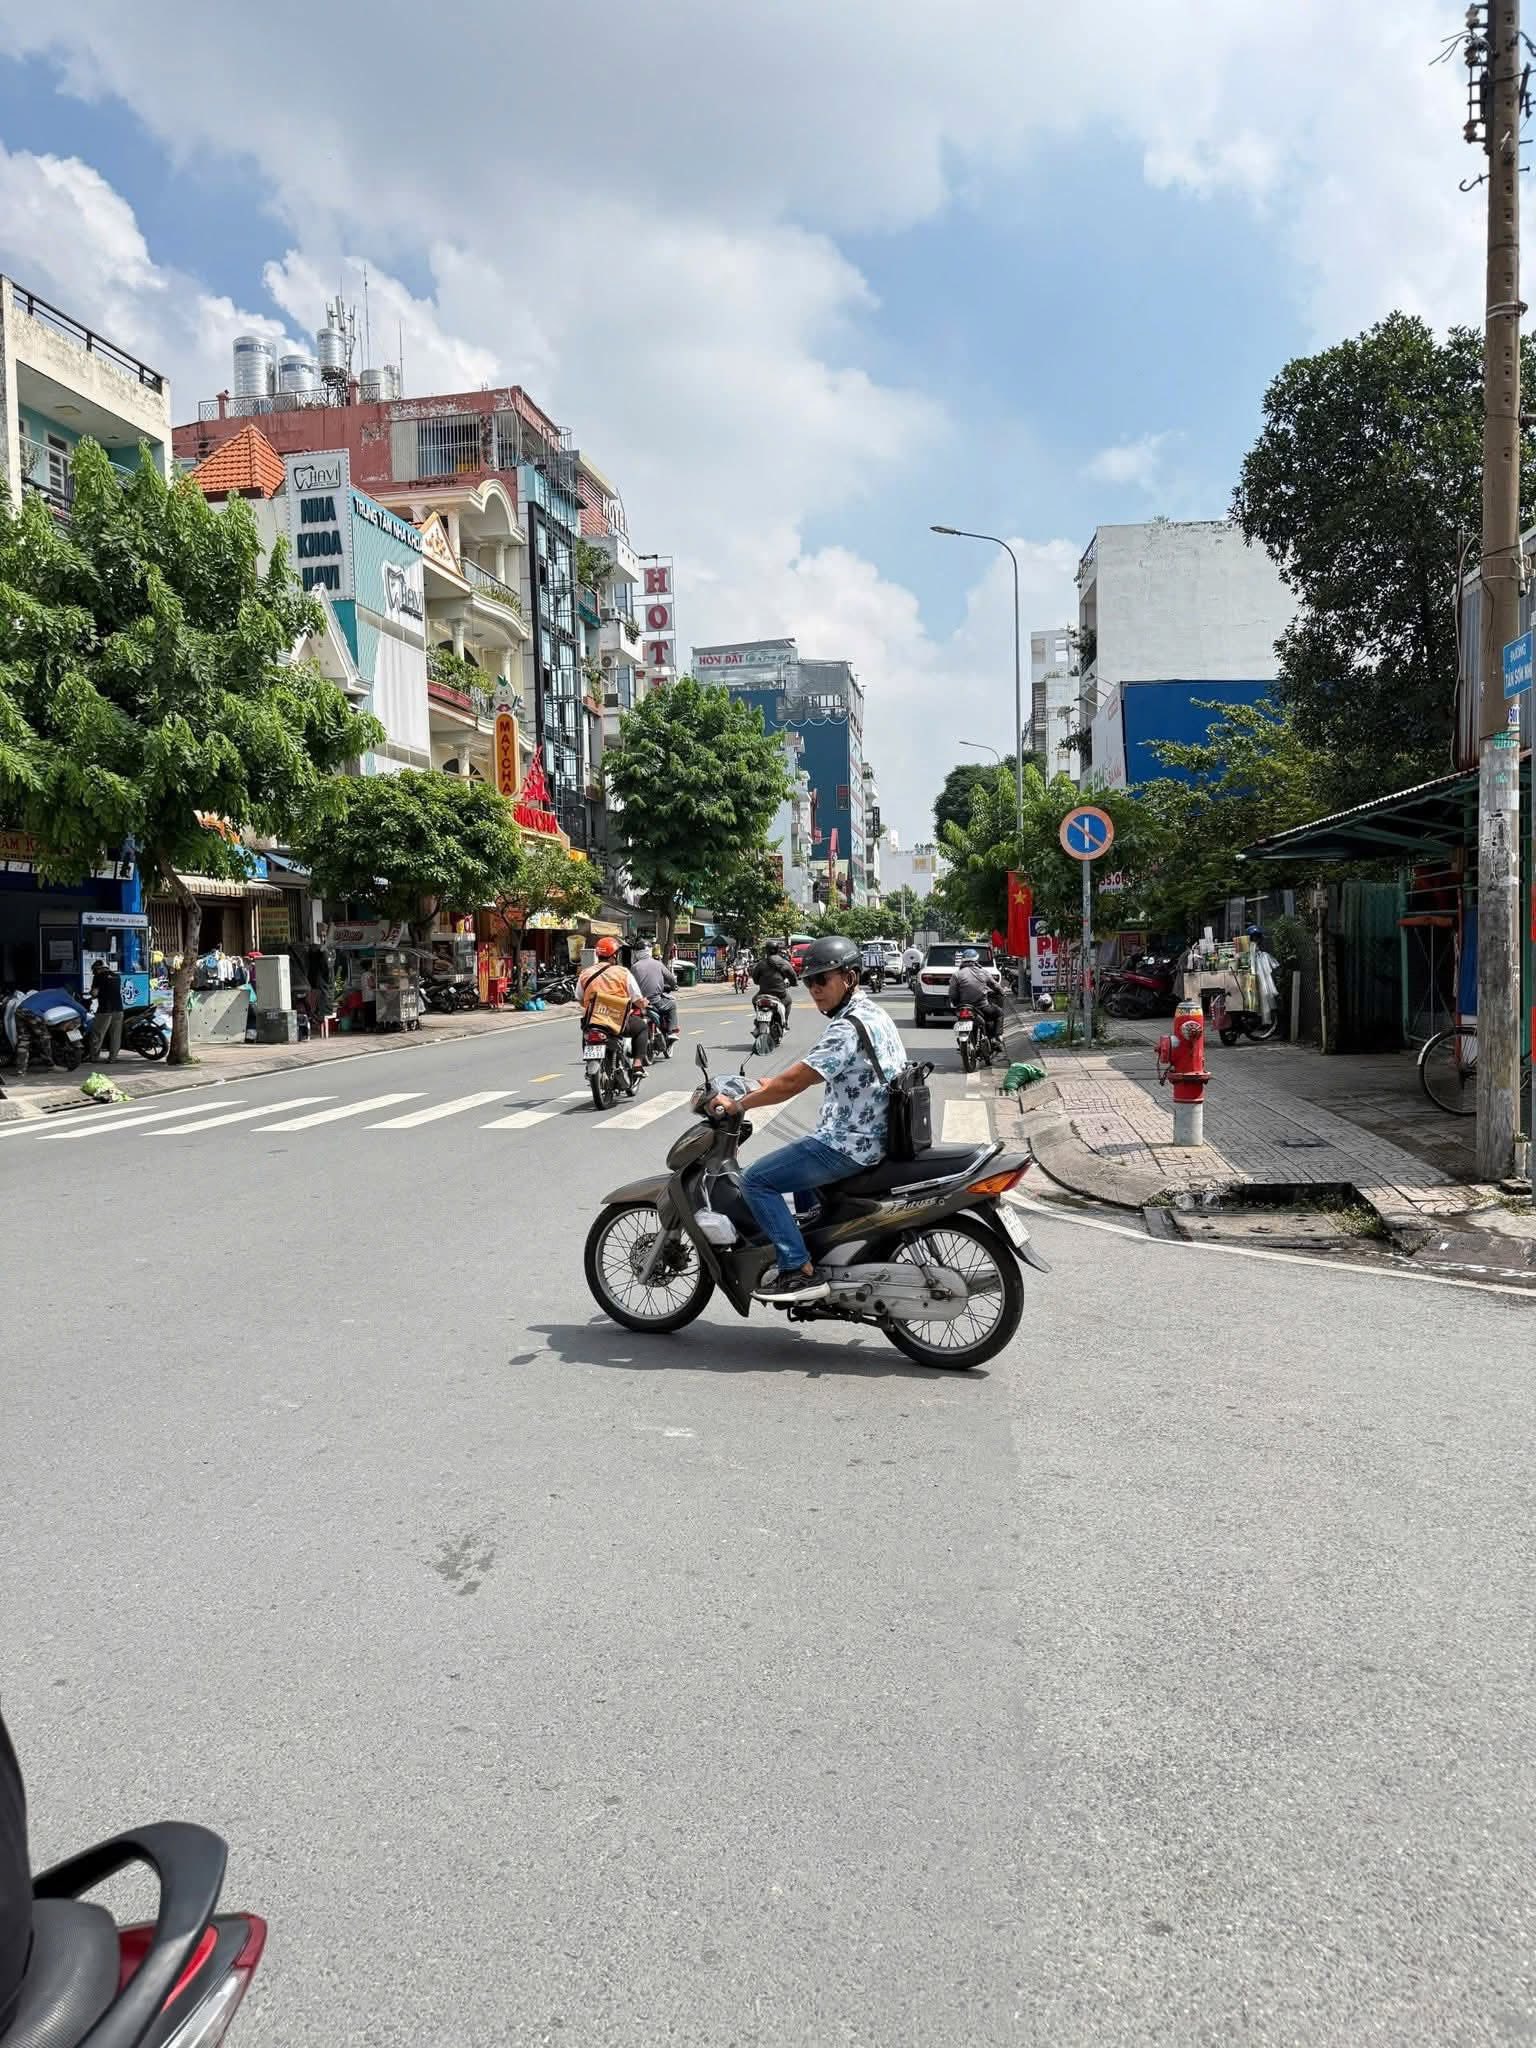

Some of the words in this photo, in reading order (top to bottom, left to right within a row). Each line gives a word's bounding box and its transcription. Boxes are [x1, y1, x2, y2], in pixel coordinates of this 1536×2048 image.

[310, 468, 338, 485] HAVI
[300, 495, 336, 524] NHA
[297, 530, 342, 559] KHOA
[302, 565, 340, 592] HAVI
[646, 567, 669, 688] HOT
[500, 720, 513, 795] MAYCHA
